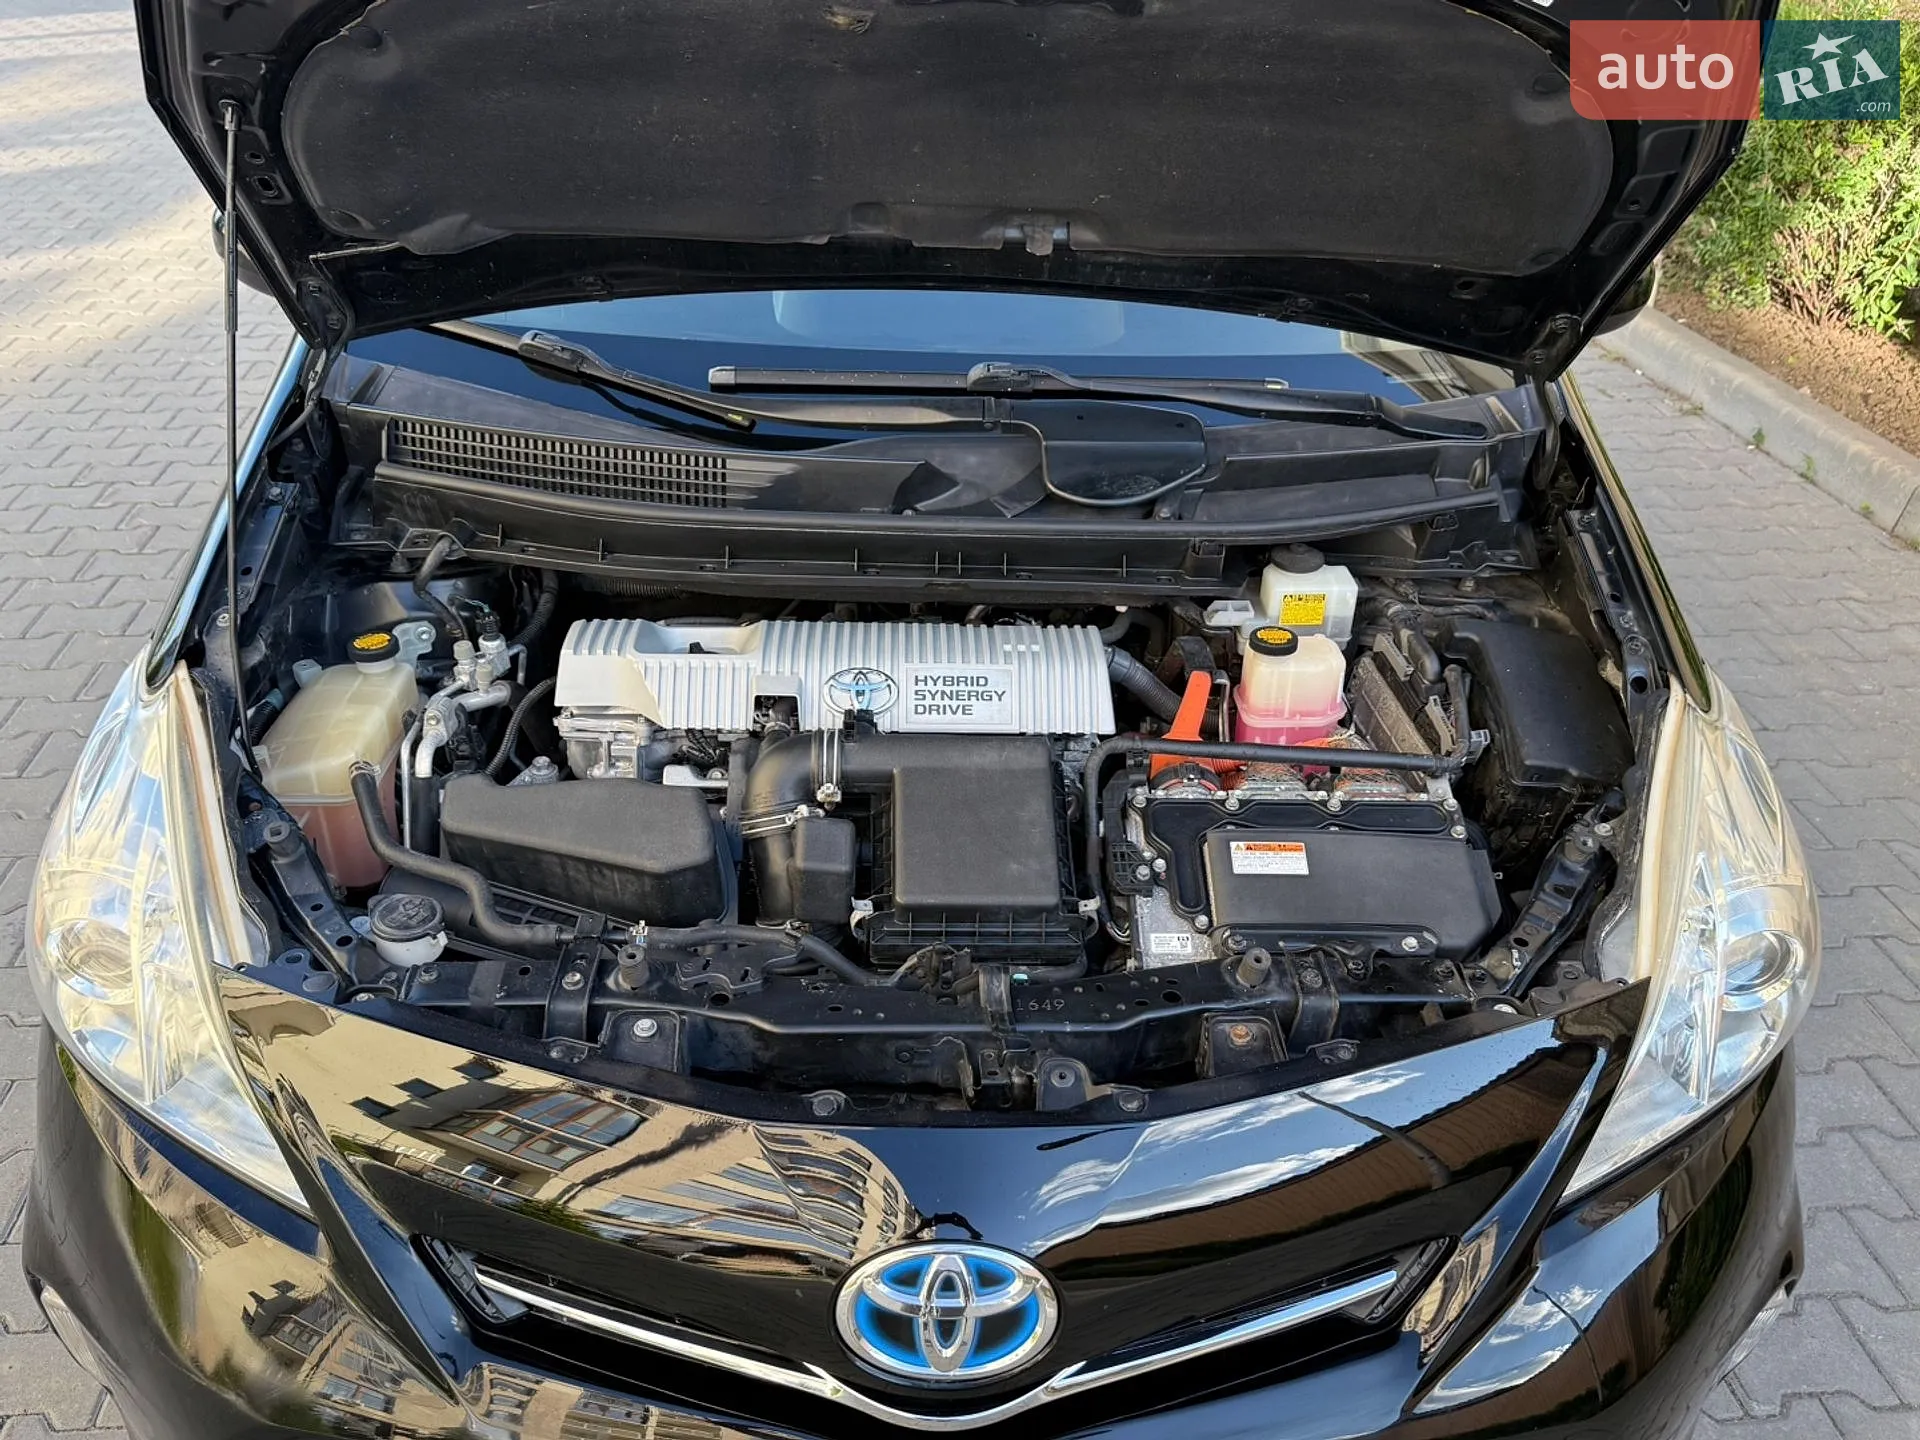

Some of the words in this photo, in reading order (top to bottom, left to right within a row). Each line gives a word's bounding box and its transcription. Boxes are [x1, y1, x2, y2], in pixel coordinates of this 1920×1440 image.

[914, 675, 989, 687] HYBRID
[914, 690, 1006, 702] SYNERGY
[914, 704, 973, 716] DRIVE
